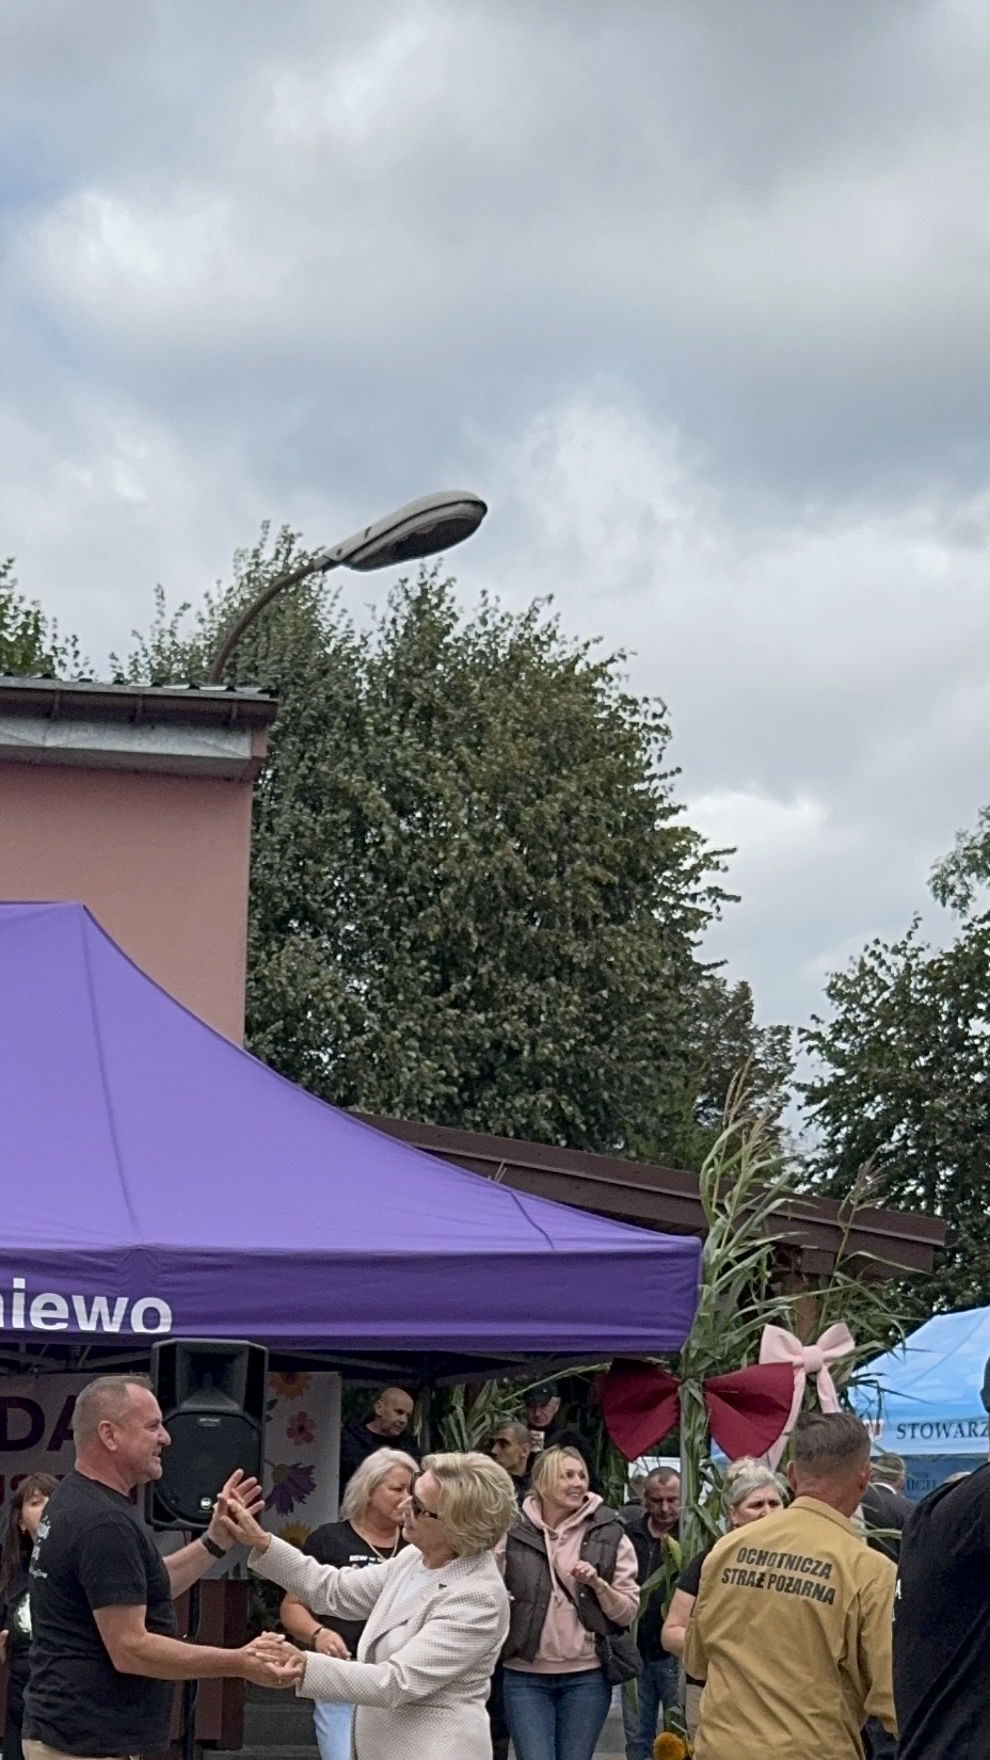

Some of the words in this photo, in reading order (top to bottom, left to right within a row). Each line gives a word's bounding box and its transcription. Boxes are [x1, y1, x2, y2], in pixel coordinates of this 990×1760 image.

[736, 1547, 832, 1580] OCHOTNICZA
[721, 1567, 765, 1588] STRAŻ
[767, 1573, 836, 1605] POŻARNA
